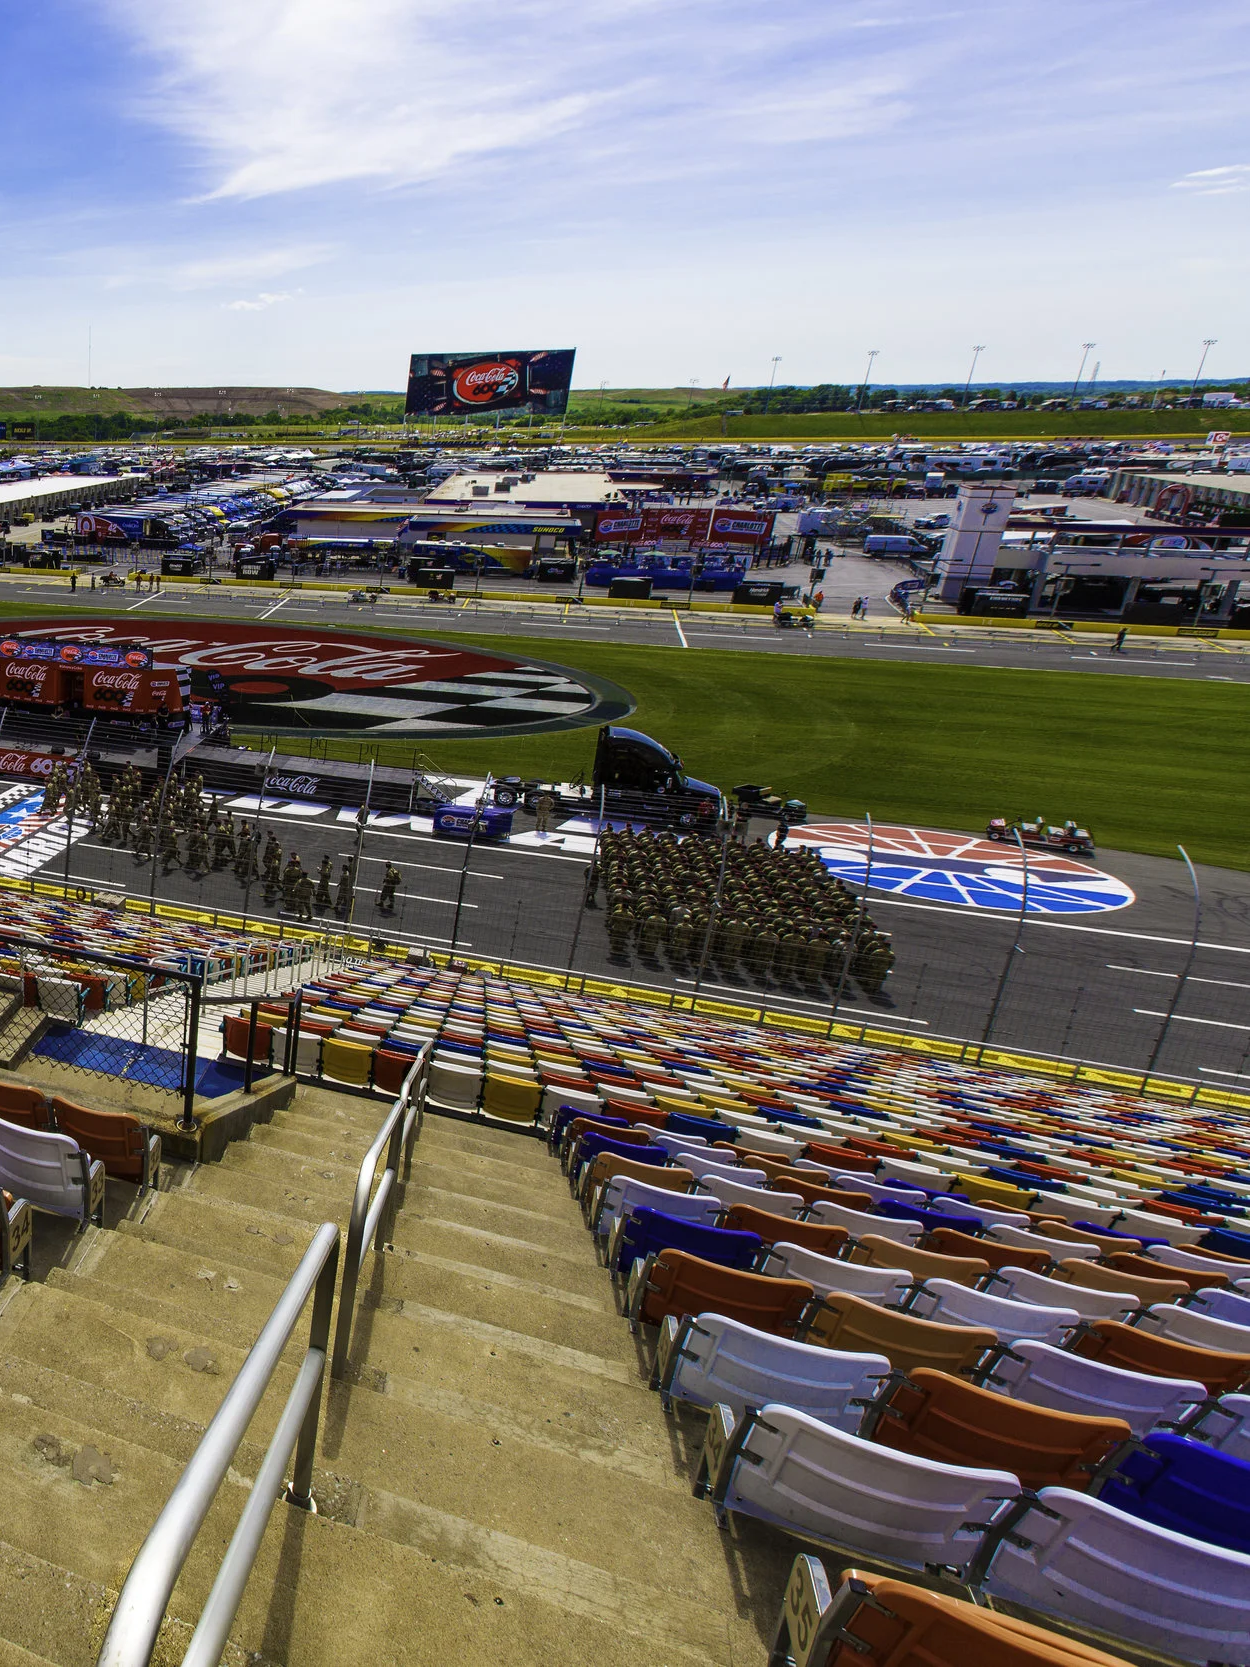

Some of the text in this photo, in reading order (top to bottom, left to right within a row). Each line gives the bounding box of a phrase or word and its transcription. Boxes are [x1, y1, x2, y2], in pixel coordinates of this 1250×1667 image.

[465, 367, 507, 386] Coca-Cola
[473, 383, 498, 396] 600
[661, 514, 696, 525] Coca-Cola
[5, 662, 49, 681] Coca-Cola
[92, 671, 142, 690] Coca-Cola
[6, 679, 36, 693] 600
[93, 688, 126, 704] 600
[12, 1210, 30, 1252] 34
[791, 1567, 812, 1652] 35
